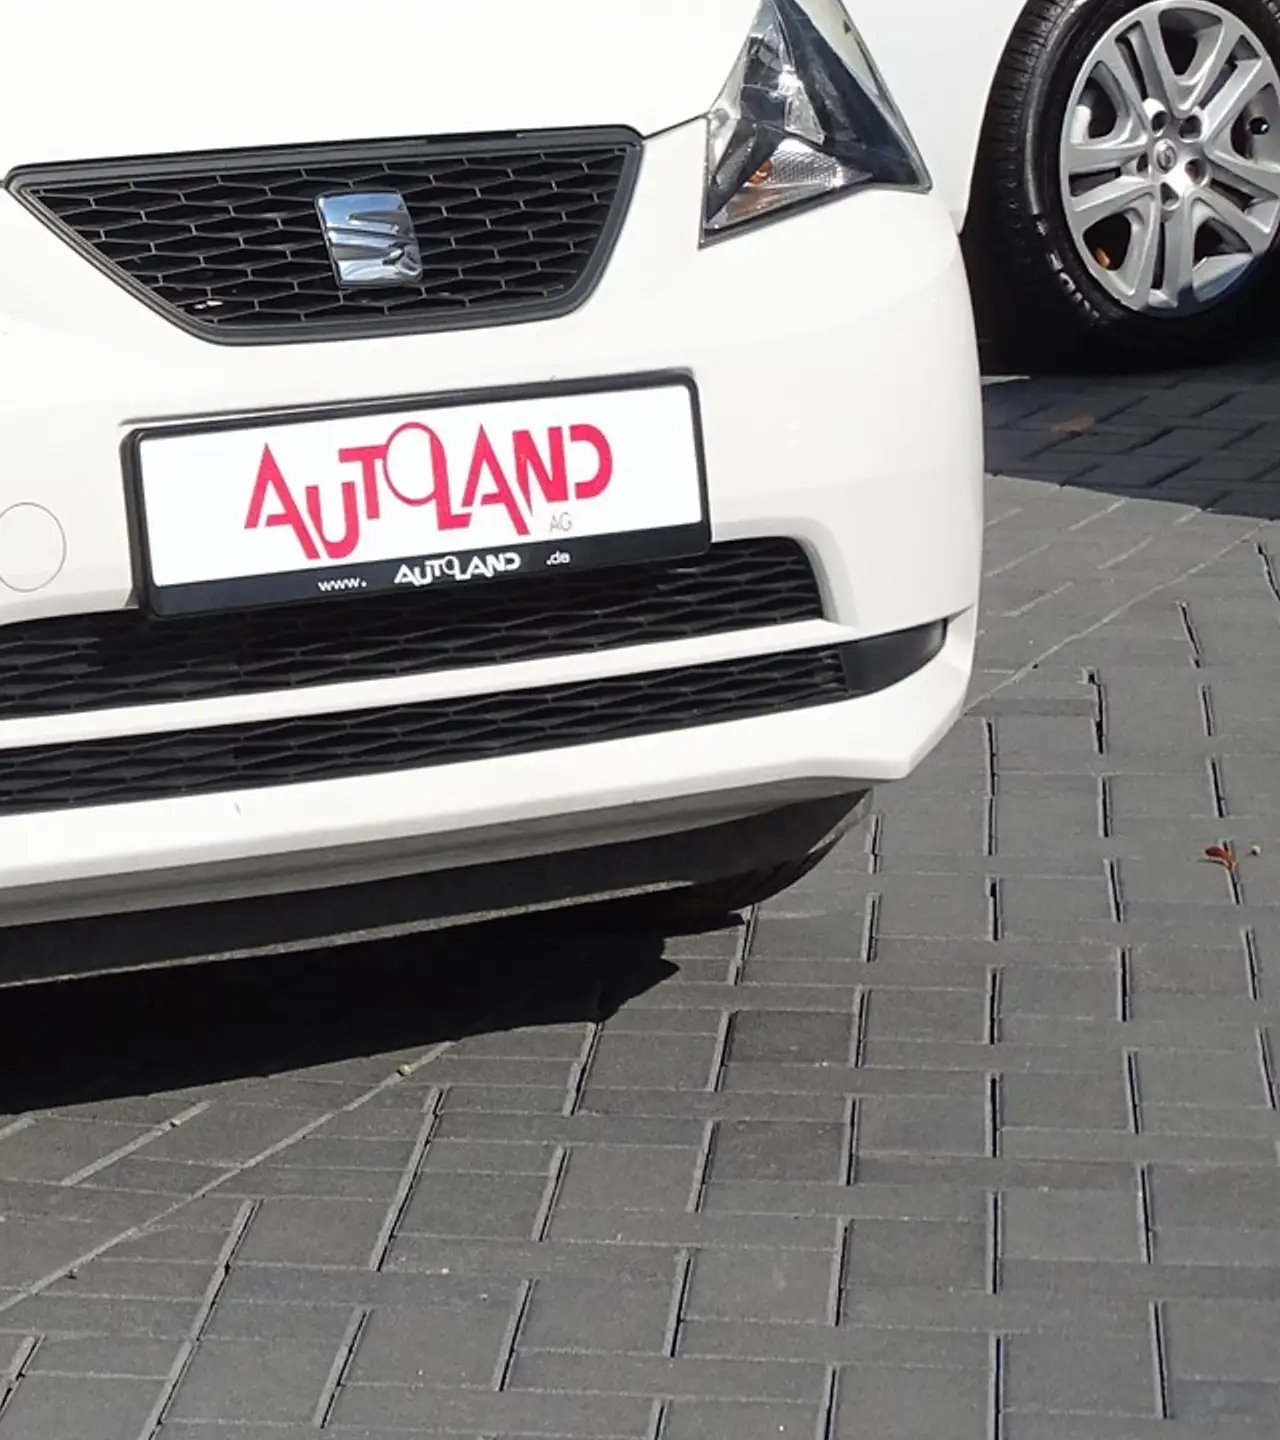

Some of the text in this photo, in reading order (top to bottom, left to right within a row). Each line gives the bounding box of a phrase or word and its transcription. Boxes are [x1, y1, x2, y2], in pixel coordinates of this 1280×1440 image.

[243, 421, 613, 560] AUTOLAND
[548, 512, 573, 534] AG
[317, 576, 368, 592] www.
[393, 551, 522, 587] AUTOLAND
